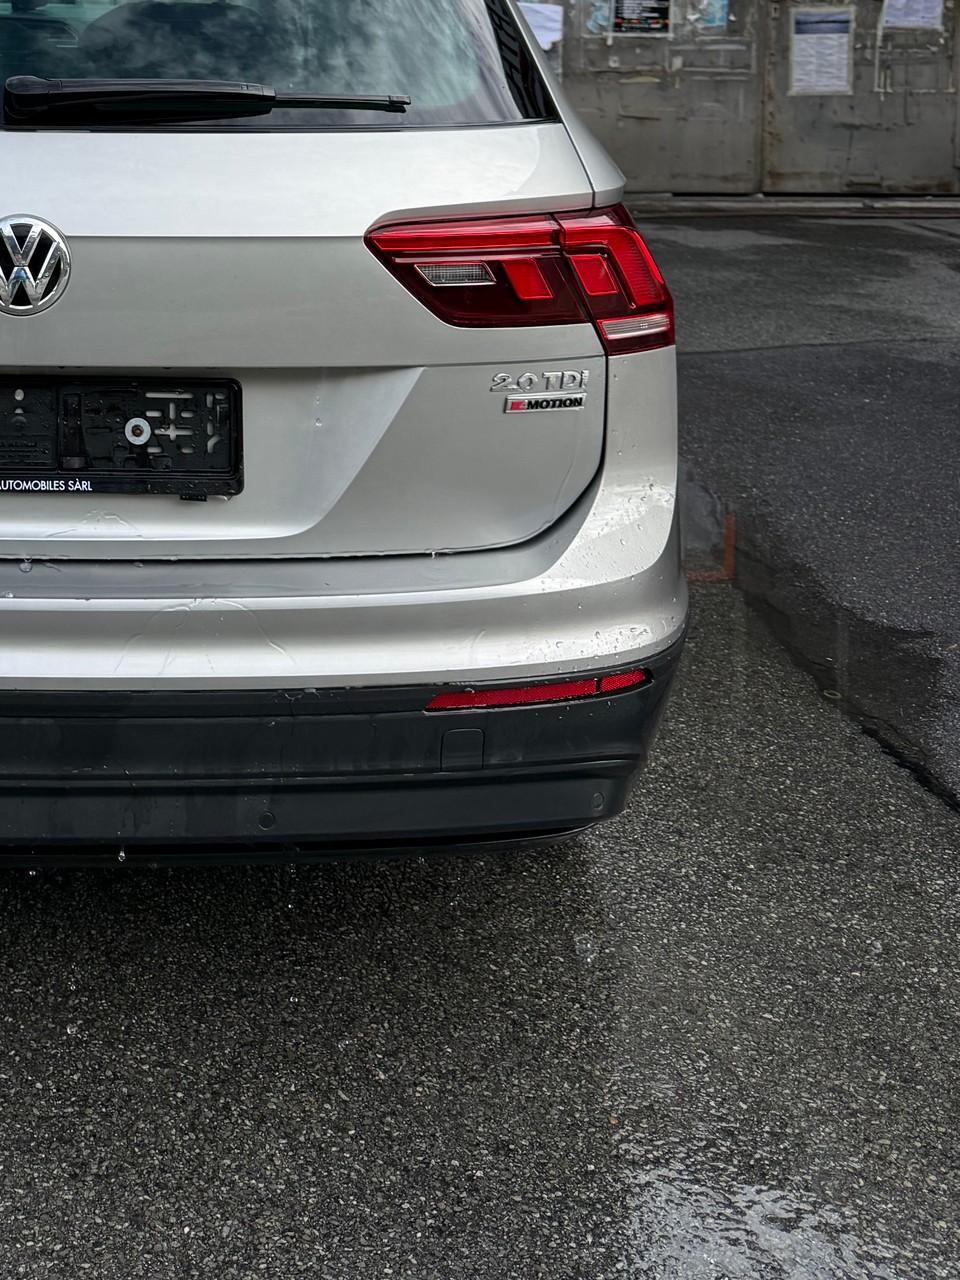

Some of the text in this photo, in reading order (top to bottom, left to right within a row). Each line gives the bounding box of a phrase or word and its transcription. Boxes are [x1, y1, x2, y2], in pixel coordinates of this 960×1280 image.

[490, 369, 590, 394] 2.0 TDI
[67, 478, 93, 492] SÀRL
